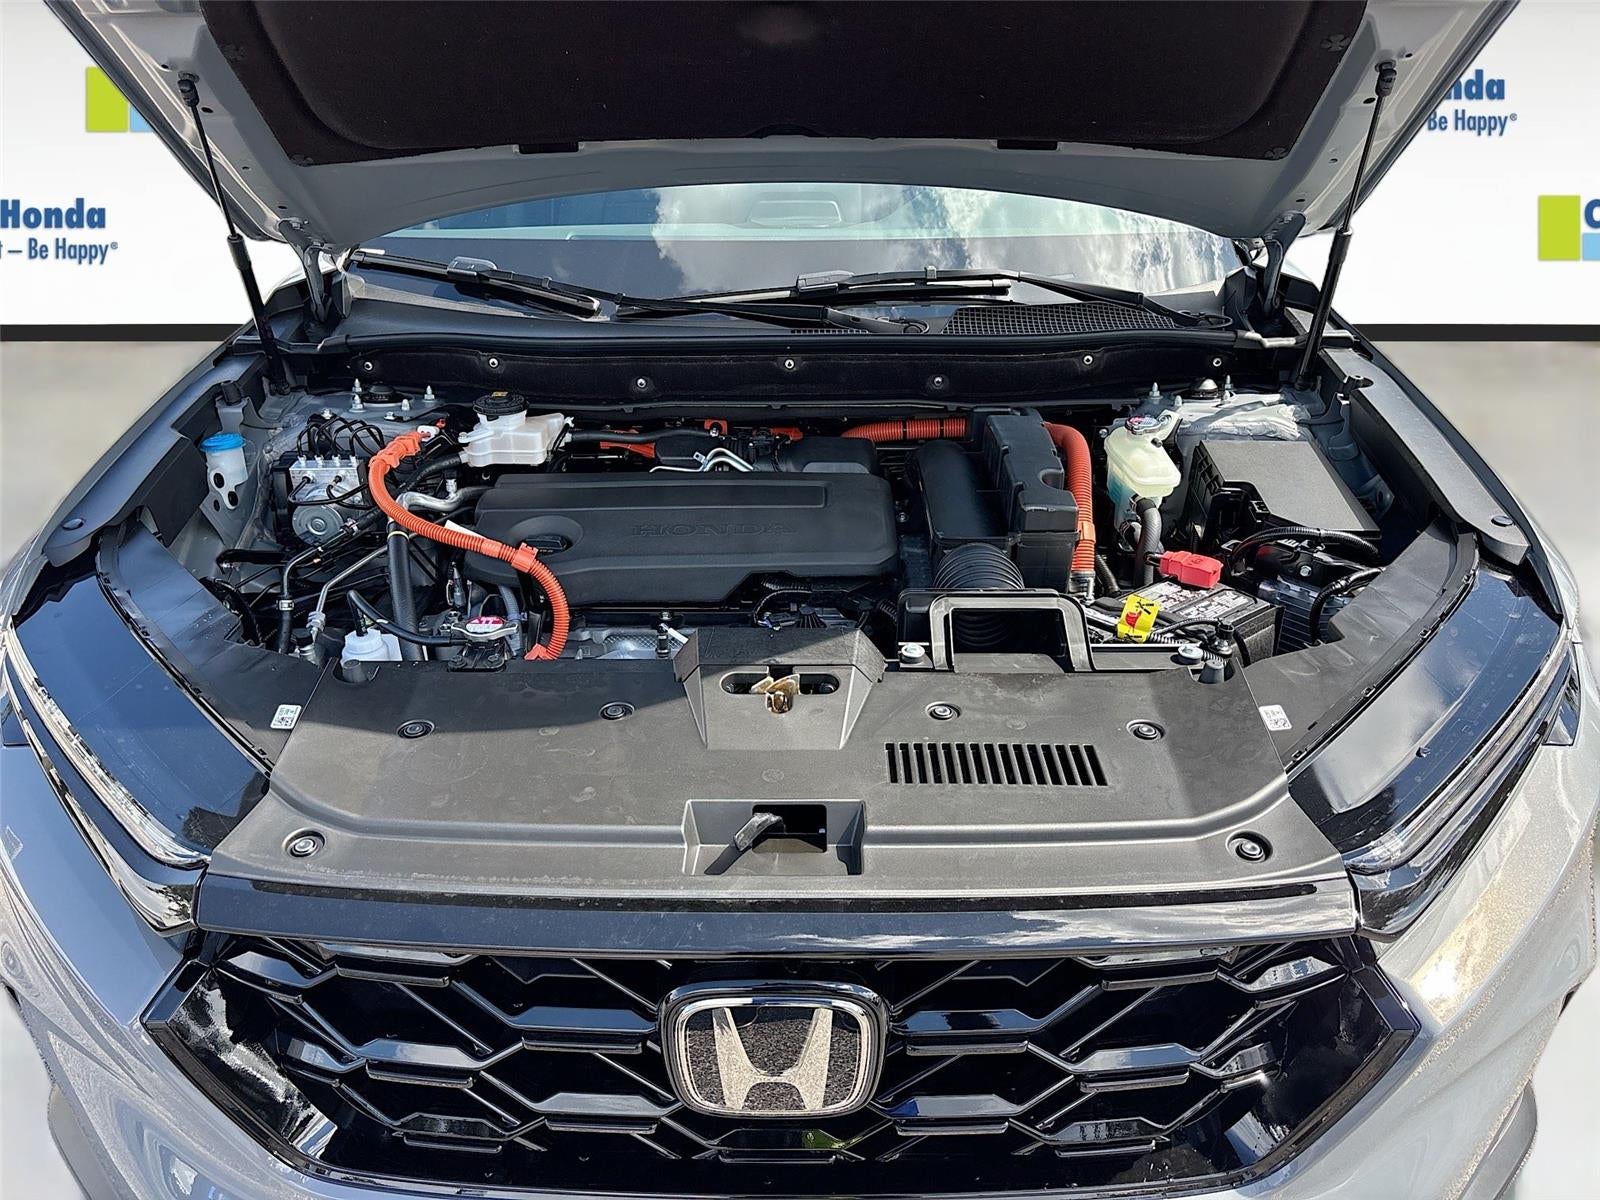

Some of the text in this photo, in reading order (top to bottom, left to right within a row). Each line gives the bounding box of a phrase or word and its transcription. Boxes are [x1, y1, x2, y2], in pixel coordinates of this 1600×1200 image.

[1427, 109, 1448, 131] Be
[0, 198, 106, 229] Honda
[28, 237, 49, 260] Be
